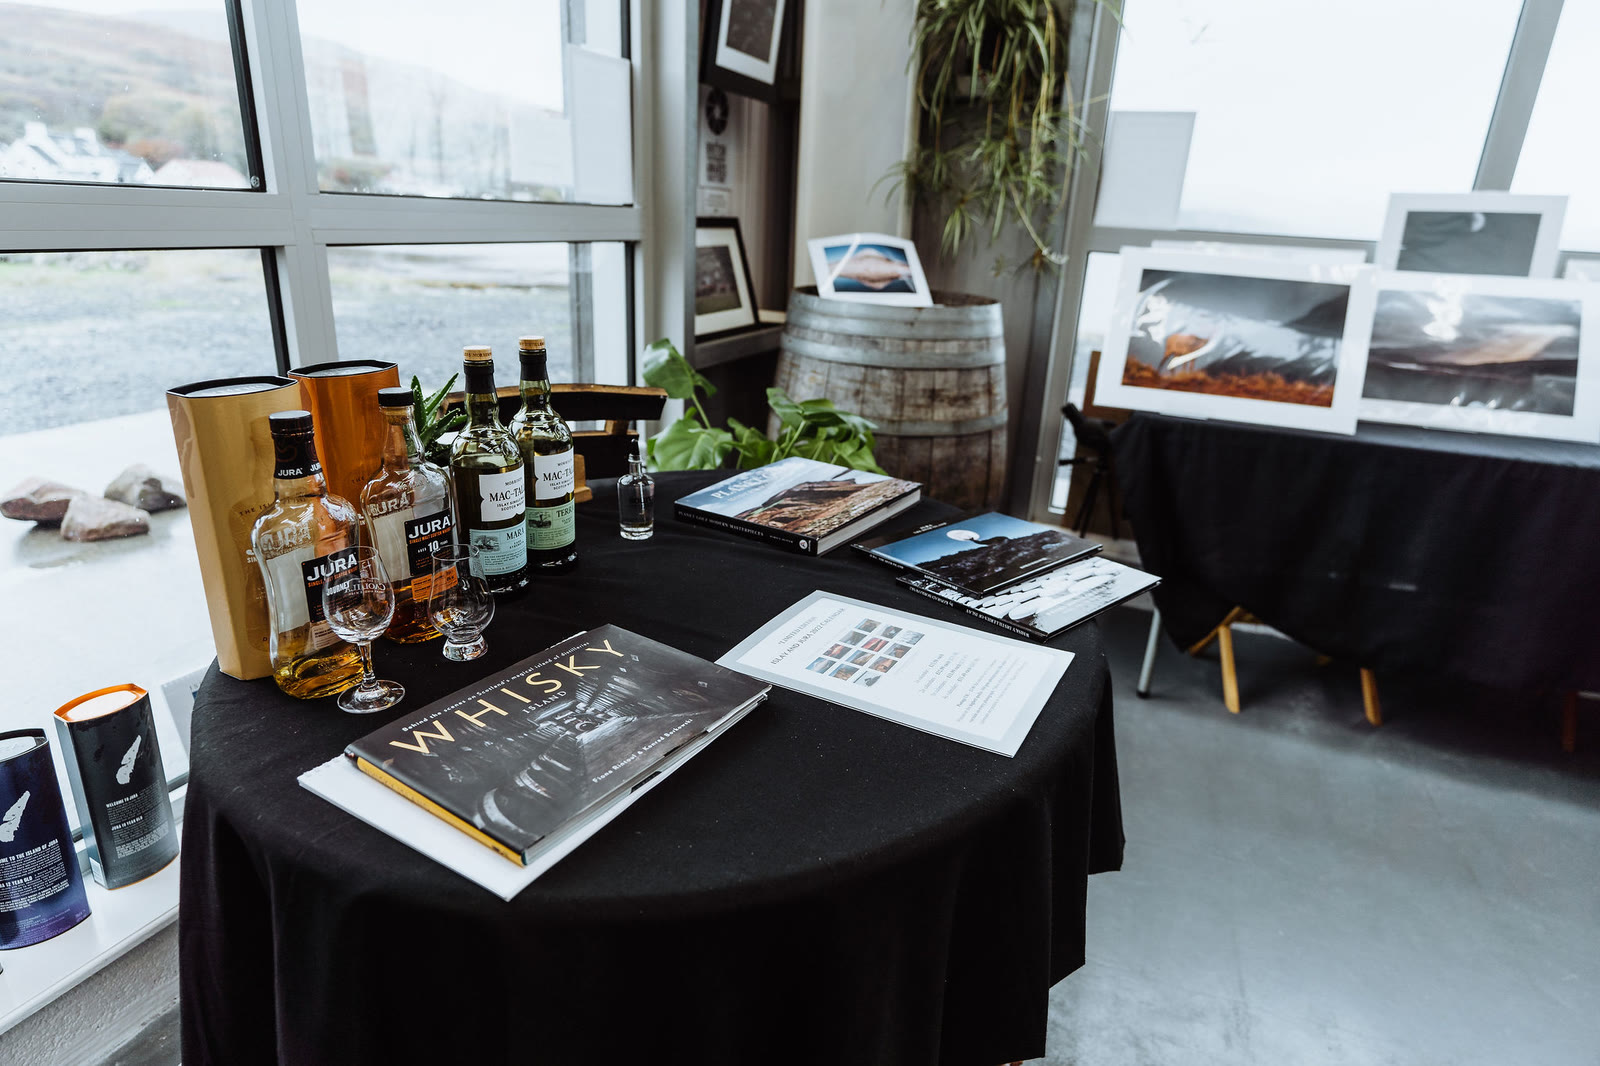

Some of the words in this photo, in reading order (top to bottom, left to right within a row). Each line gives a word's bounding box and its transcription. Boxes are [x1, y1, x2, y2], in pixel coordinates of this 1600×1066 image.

[278, 467, 303, 477] JURA
[239, 507, 255, 516] THE
[408, 515, 451, 539] JURA
[729, 524, 764, 537] MASTERPIECES
[428, 540, 439, 552] 10
[307, 553, 358, 582] JURA
[326, 580, 351, 596] JOURNEY
[770, 651, 788, 665] ISLAY
[787, 642, 800, 654] AND
[388, 638, 625, 755] WHISKY
[401, 717, 429, 733] Behind
[429, 711, 442, 720] the
[443, 699, 467, 713] scenes
[467, 693, 477, 702] on
[476, 677, 511, 697] Scotland's
[511, 666, 534, 681] magical
[535, 657, 553, 669] island
[560, 641, 590, 657] distilleries
[522, 690, 567, 714] ISLAND
[592, 769, 613, 783] Fiona
[612, 753, 637, 771] Rintoul
[642, 736, 665, 751] Konrad
[663, 718, 693, 737] Borkowski
[106, 799, 124, 808] WELCOME
[25, 846, 41, 857] ISLAND
[48, 838, 59, 847] JURA
[11, 878, 23, 886] YEAR
